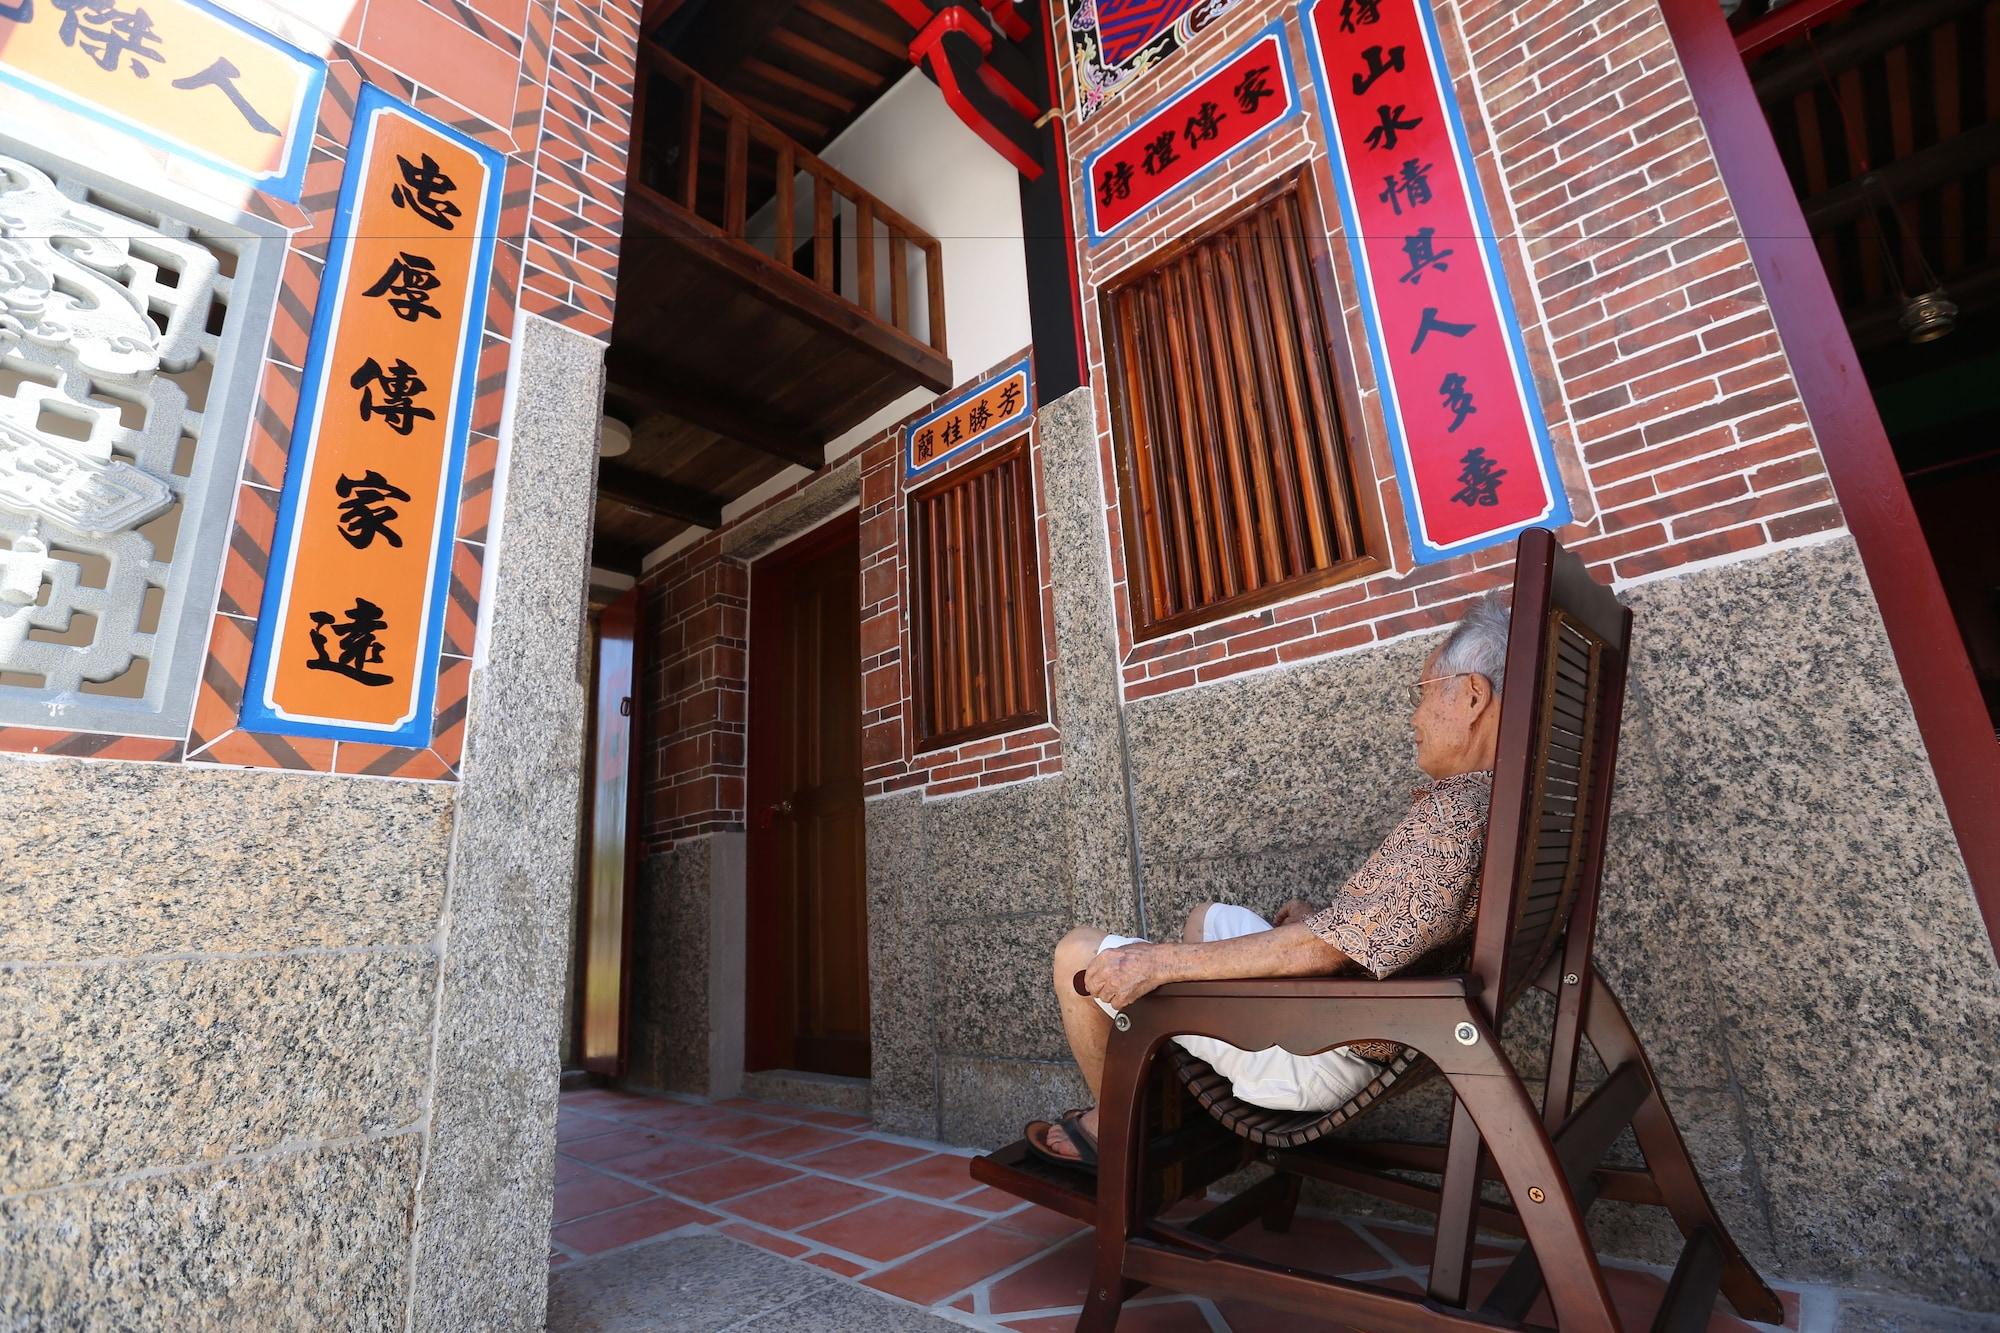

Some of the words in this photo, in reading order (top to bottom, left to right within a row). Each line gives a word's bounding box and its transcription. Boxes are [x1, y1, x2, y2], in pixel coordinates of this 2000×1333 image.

[306, 153, 462, 687] 忠厚傳家遠
